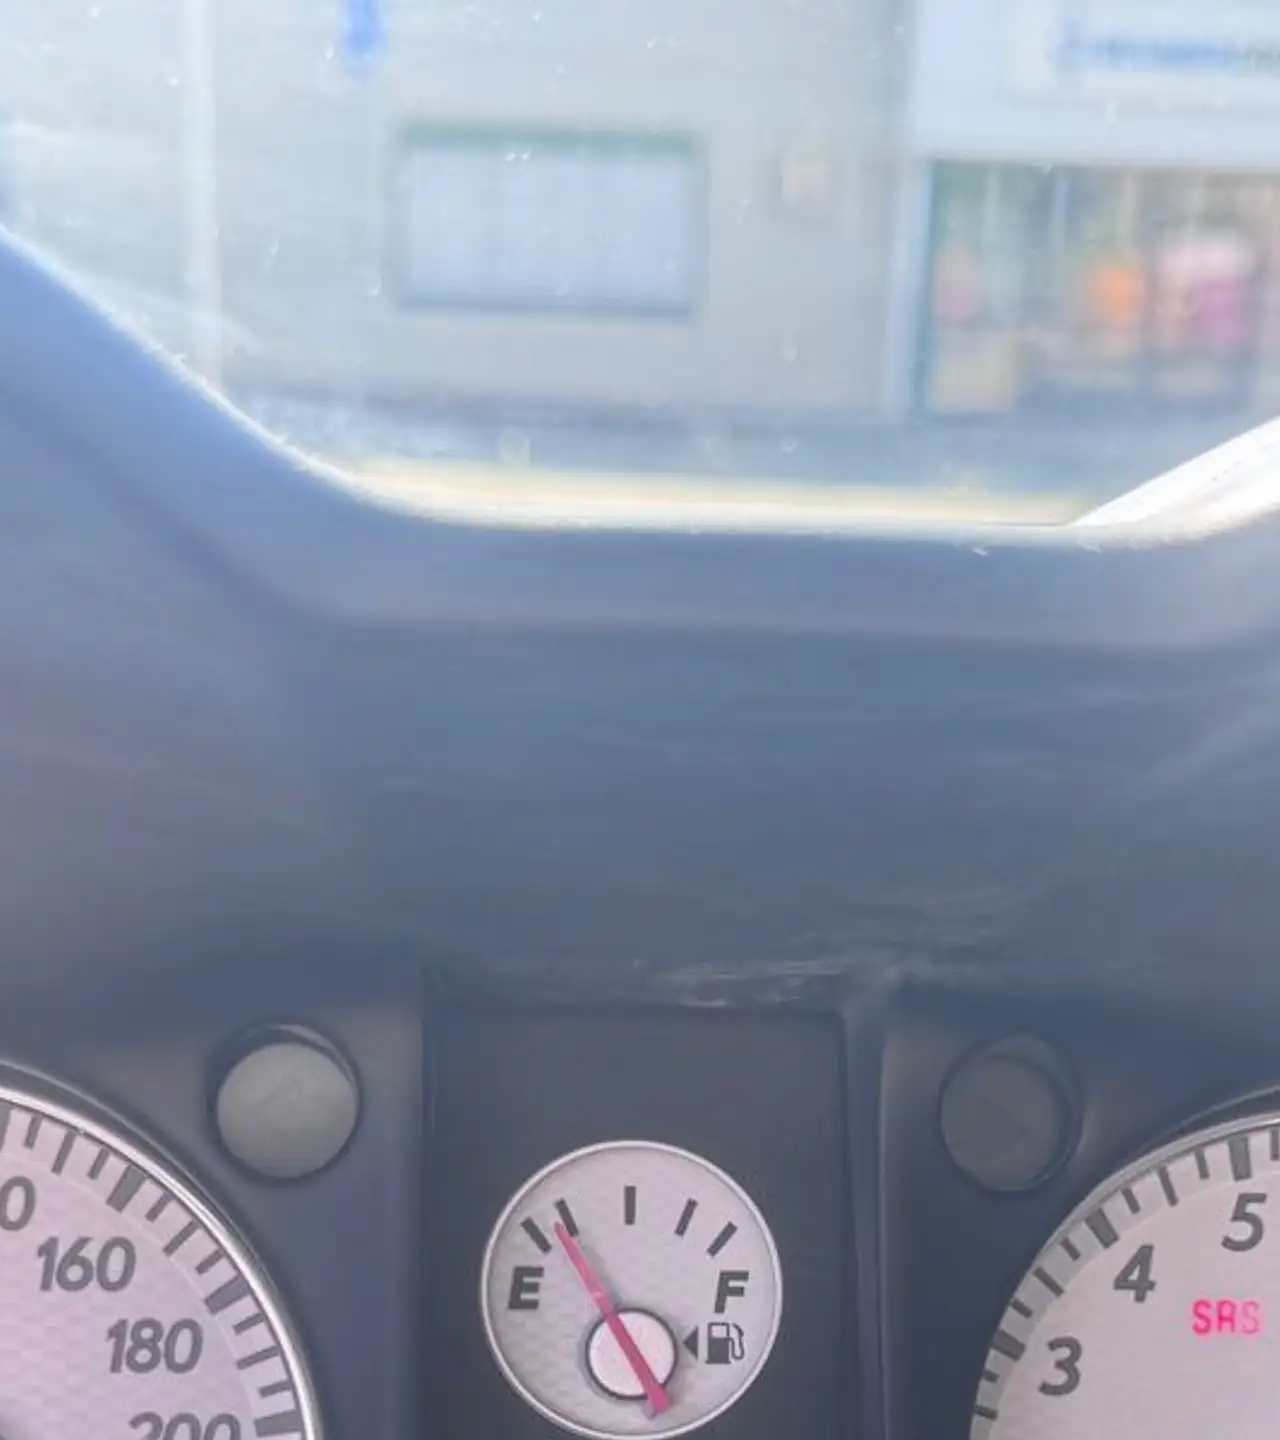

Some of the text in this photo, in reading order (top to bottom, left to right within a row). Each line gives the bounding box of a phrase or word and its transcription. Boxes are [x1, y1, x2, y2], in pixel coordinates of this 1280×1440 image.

[1220, 1192, 1268, 1253] 5
[36, 1235, 137, 1293] 160
[506, 1265, 546, 1312] E
[713, 1269, 751, 1315] F
[1114, 1245, 1158, 1304] 4
[106, 1317, 204, 1374] 180
[1037, 1336, 1083, 1397] 3
